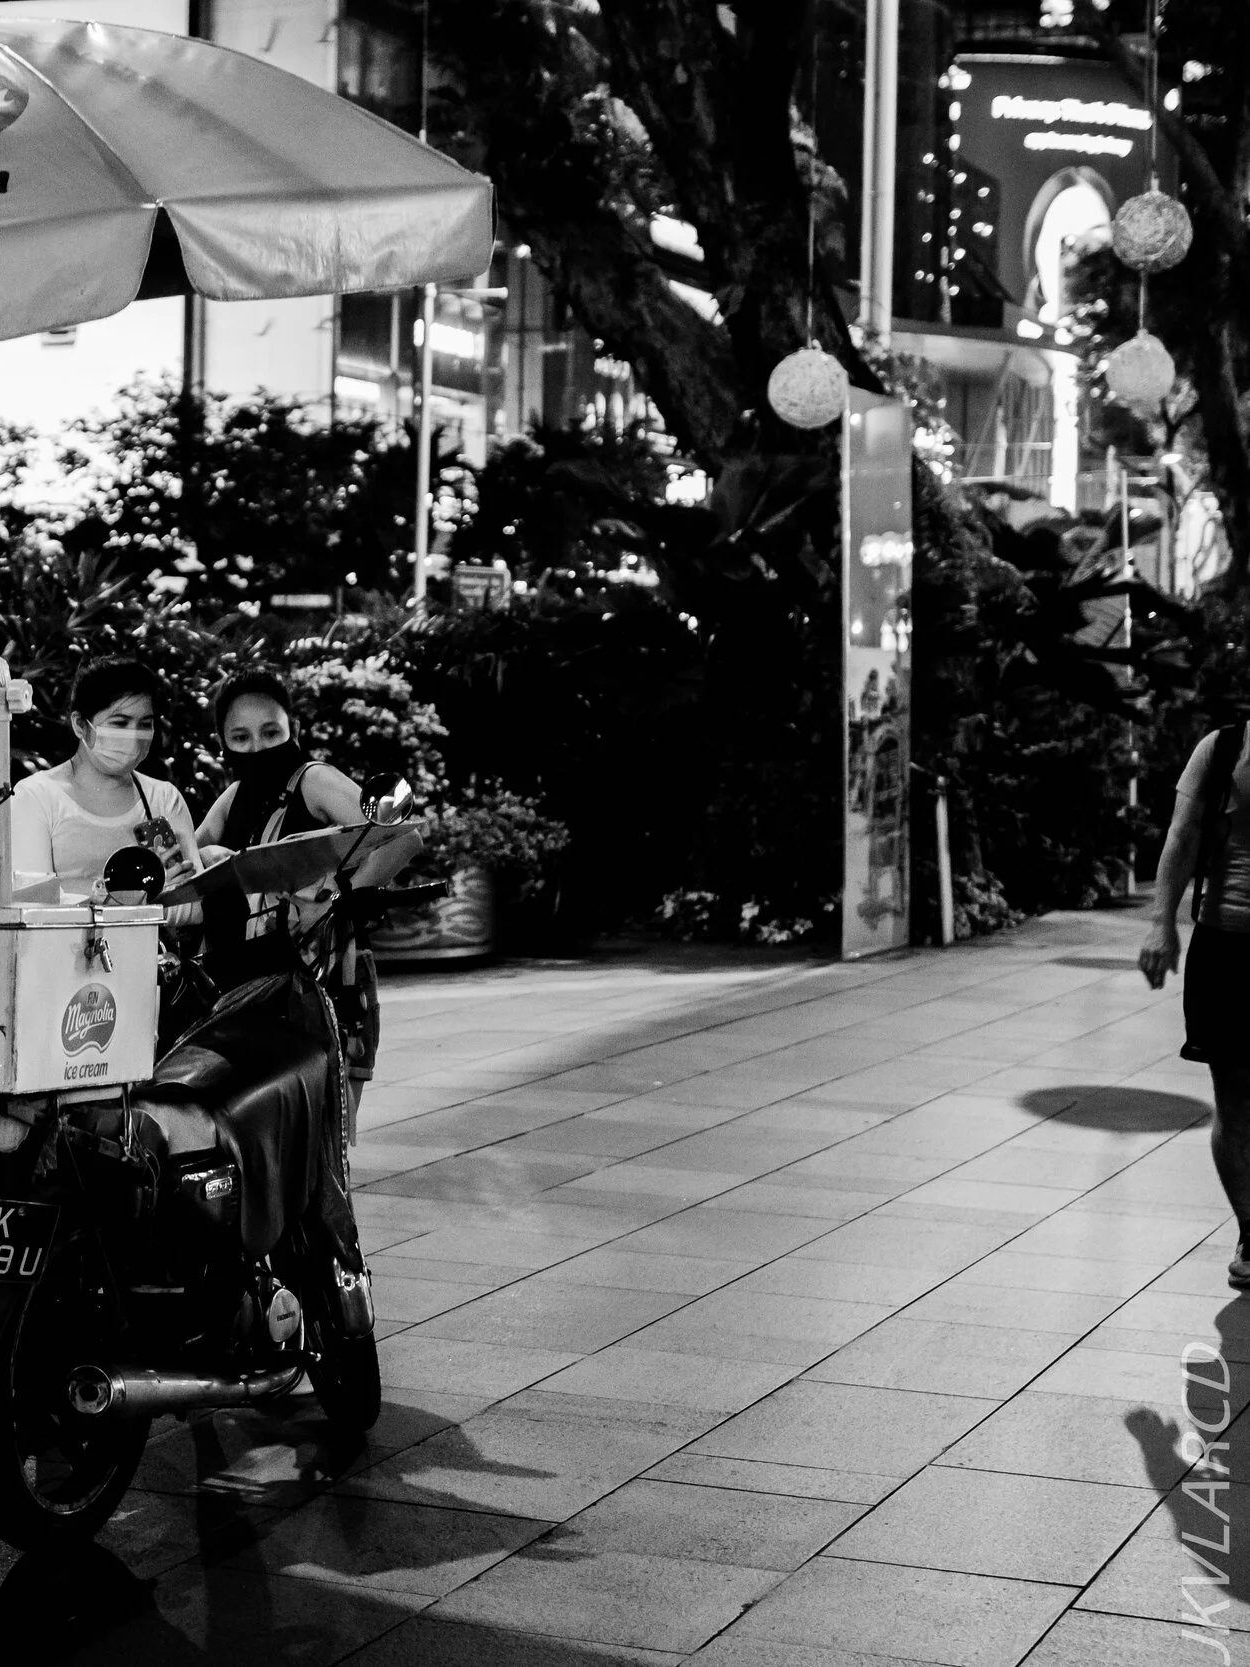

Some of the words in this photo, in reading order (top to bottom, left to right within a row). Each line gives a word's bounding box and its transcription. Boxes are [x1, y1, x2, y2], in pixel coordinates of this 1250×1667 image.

[64, 1000, 115, 1040] Magnolia
[64, 1061, 78, 1080] ice
[79, 1061, 109, 1078] cream
